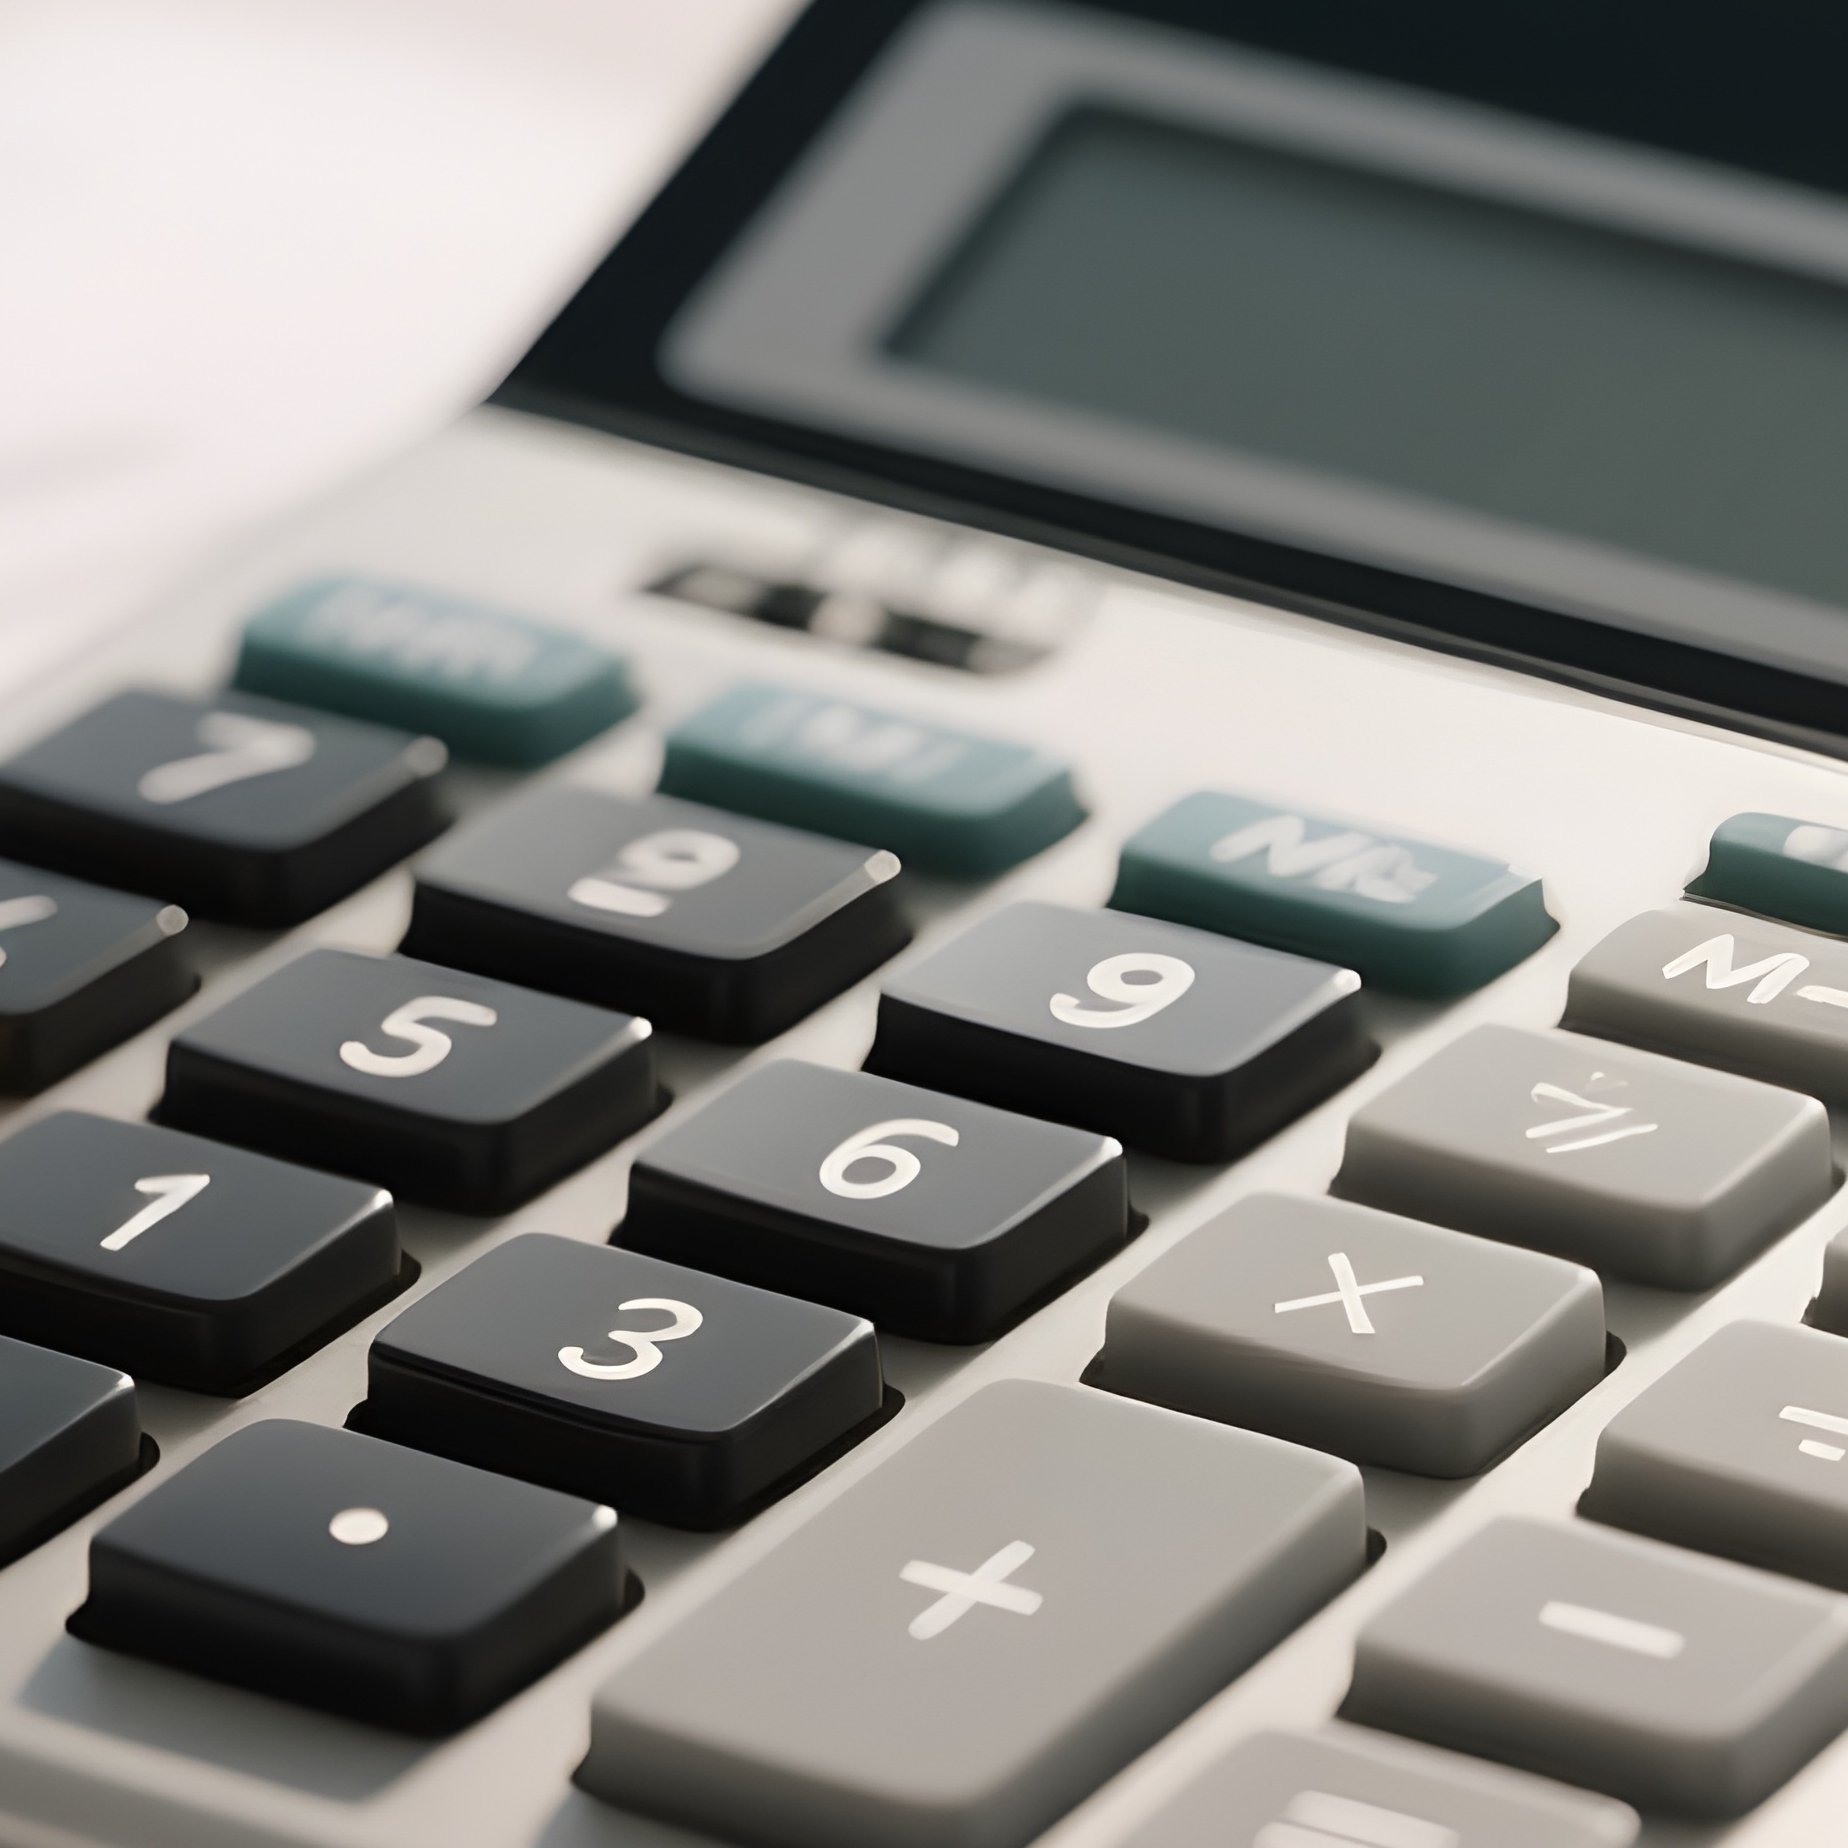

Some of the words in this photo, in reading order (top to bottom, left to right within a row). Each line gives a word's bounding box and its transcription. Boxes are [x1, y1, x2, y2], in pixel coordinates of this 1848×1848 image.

[1050, 952, 1195, 1028] 9
[339, 996, 498, 1078] 5
[819, 1118, 959, 1199] 6
[99, 1173, 211, 1251] 1
[557, 1298, 703, 1380] 3
